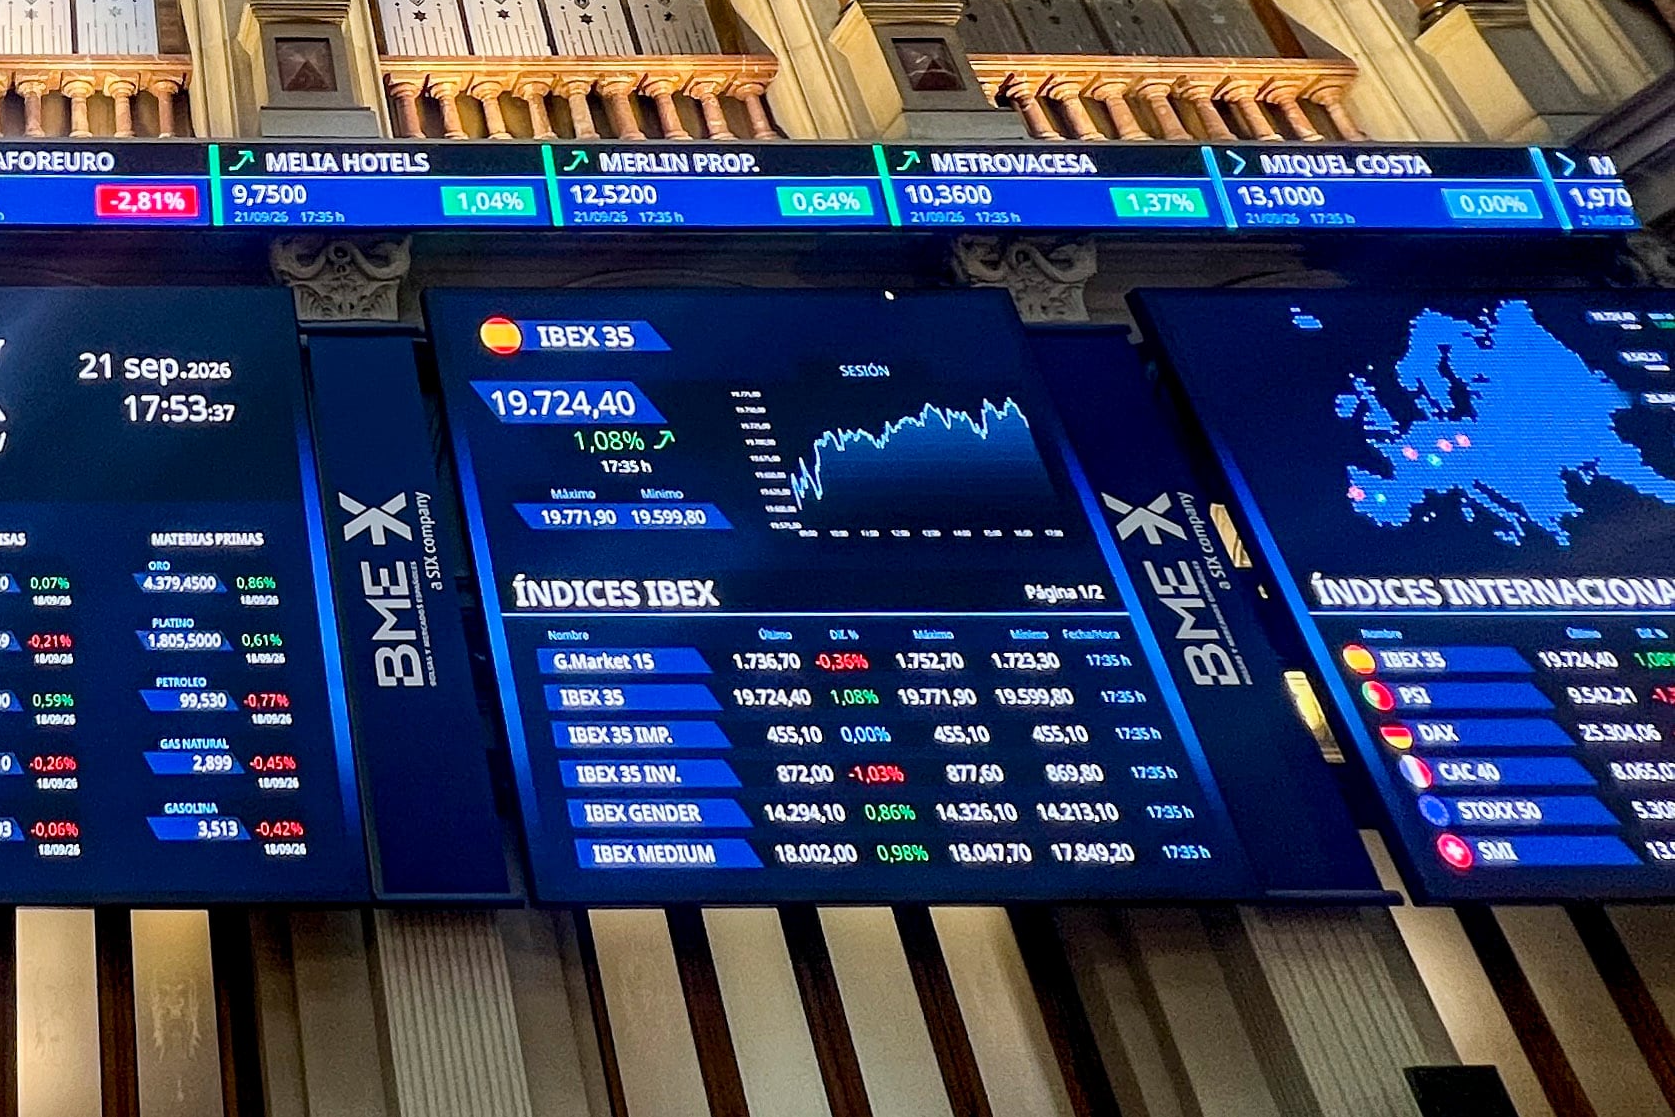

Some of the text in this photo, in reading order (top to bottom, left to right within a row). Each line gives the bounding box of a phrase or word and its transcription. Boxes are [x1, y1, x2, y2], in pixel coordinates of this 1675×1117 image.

[266, 152, 430, 172] MELIA HOTELS
[600, 153, 760, 173] MERLIN PROP.
[932, 153, 1097, 174] METROVACESA
[1261, 154, 1432, 176] MIQUEL COSTA
[110, 190, 185, 212] -2,81%
[233, 185, 524, 212] 9,7500 1,04%
[570, 185, 859, 212] 12,5200 0,64%
[905, 185, 1194, 214] 10,3600 1,37%
[1238, 186, 1527, 214] 13,1000 0,00%
[536, 325, 635, 348] IBEX 35
[78, 353, 113, 380] 21
[838, 362, 891, 377] SESIÓN
[123, 395, 235, 423] 17:53:37
[491, 389, 636, 420] 19.724,40
[574, 430, 645, 453] 1,08%
[600, 459, 652, 474] 17:35 h
[550, 487, 596, 500] Máximo
[414, 491, 435, 554] company
[540, 508, 707, 526] 19.771,90 19.599,80
[1176, 491, 1214, 554] company
[151, 533, 264, 547] MATERIAS PRIMAS
[424, 556, 441, 579] SIX
[1204, 555, 1225, 578] SIX
[512, 574, 1105, 608] ÍNDICES IBEX Página 1/2
[1310, 572, 1675, 606] ÍNDICES INTERNACIONA
[360, 561, 424, 687] BME
[1142, 561, 1241, 685] BME
[552, 652, 655, 671] G.Market 15
[1379, 651, 1447, 669] IBEX 35
[559, 688, 625, 707] IBEX 35
[1399, 687, 1433, 705] PSI
[567, 726, 674, 745] IBEX 35 IMP.
[1417, 724, 1460, 742] DAX
[576, 764, 682, 784] IBEX 35 INV.
[1438, 763, 1501, 782] CAC 40
[584, 803, 702, 823] IBEX GENDER
[1457, 801, 1543, 821] STOXX 50
[197, 820, 239, 839] 3,513
[591, 844, 716, 865] IBEX MEDIUM
[1477, 840, 1520, 862] SMI
